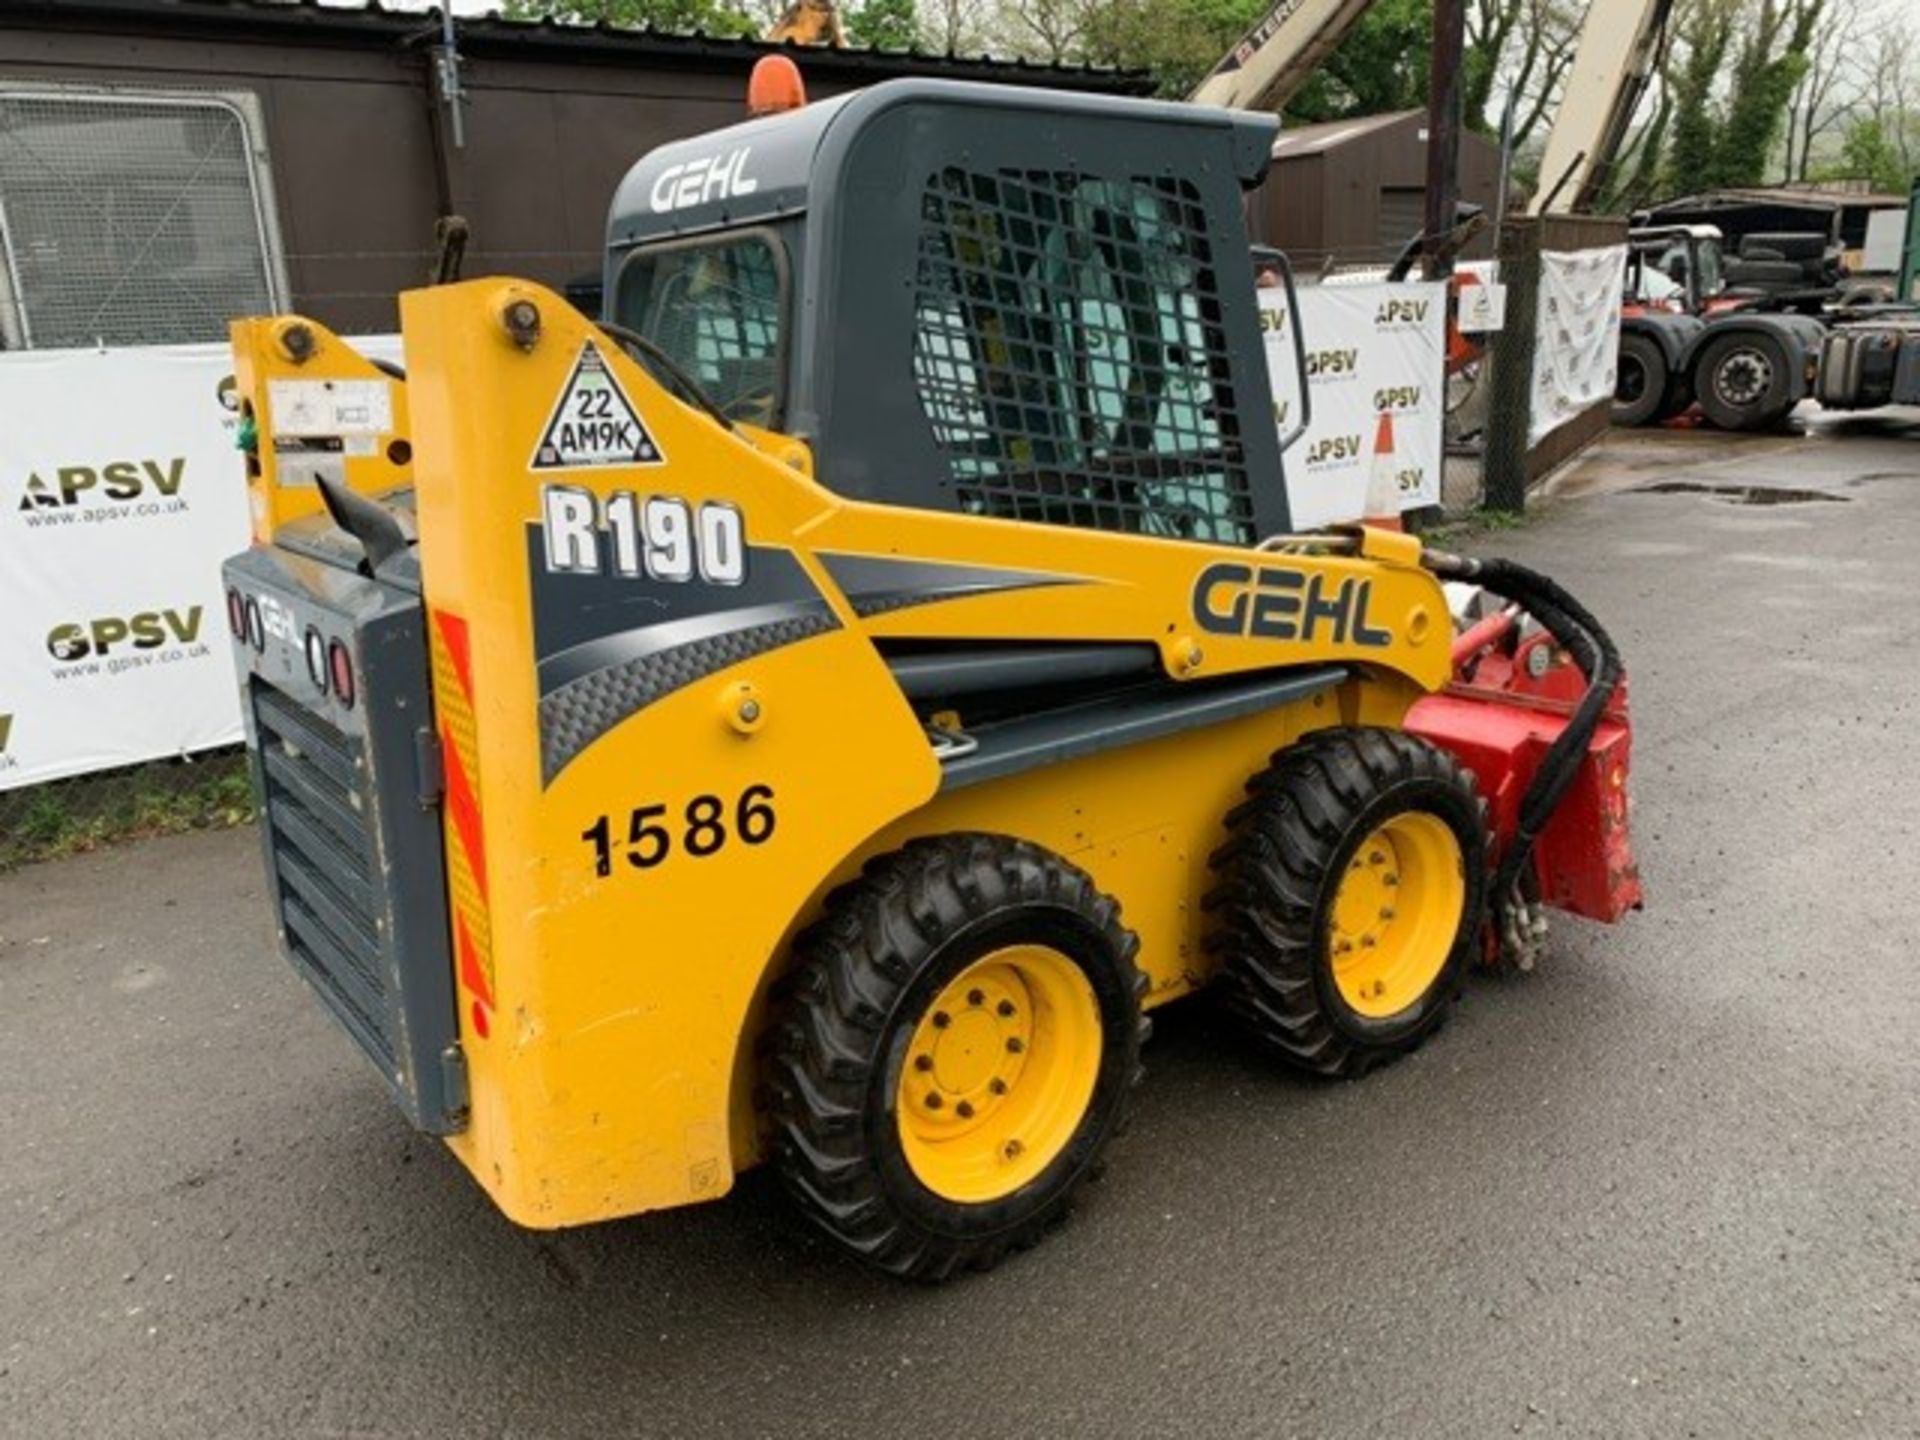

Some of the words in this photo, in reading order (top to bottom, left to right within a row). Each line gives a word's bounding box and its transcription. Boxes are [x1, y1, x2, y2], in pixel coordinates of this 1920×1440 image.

[650, 146, 758, 214] GEHL
[1374, 300, 1428, 325] APSV
[1306, 349, 1358, 375] GPSV
[576, 389, 613, 419] 22
[1373, 387, 1420, 412] GPSV
[560, 421, 634, 453] AM9K
[1305, 435, 1360, 465] APSV
[19, 457, 186, 511] APSV
[26, 499, 189, 528] www.apsv.co.uk
[542, 484, 744, 585] R190
[1193, 562, 1392, 646] GEHL
[47, 605, 203, 661] GPSV
[52, 644, 210, 679] www.gpsv.co.uk
[582, 784, 775, 878] 1586
